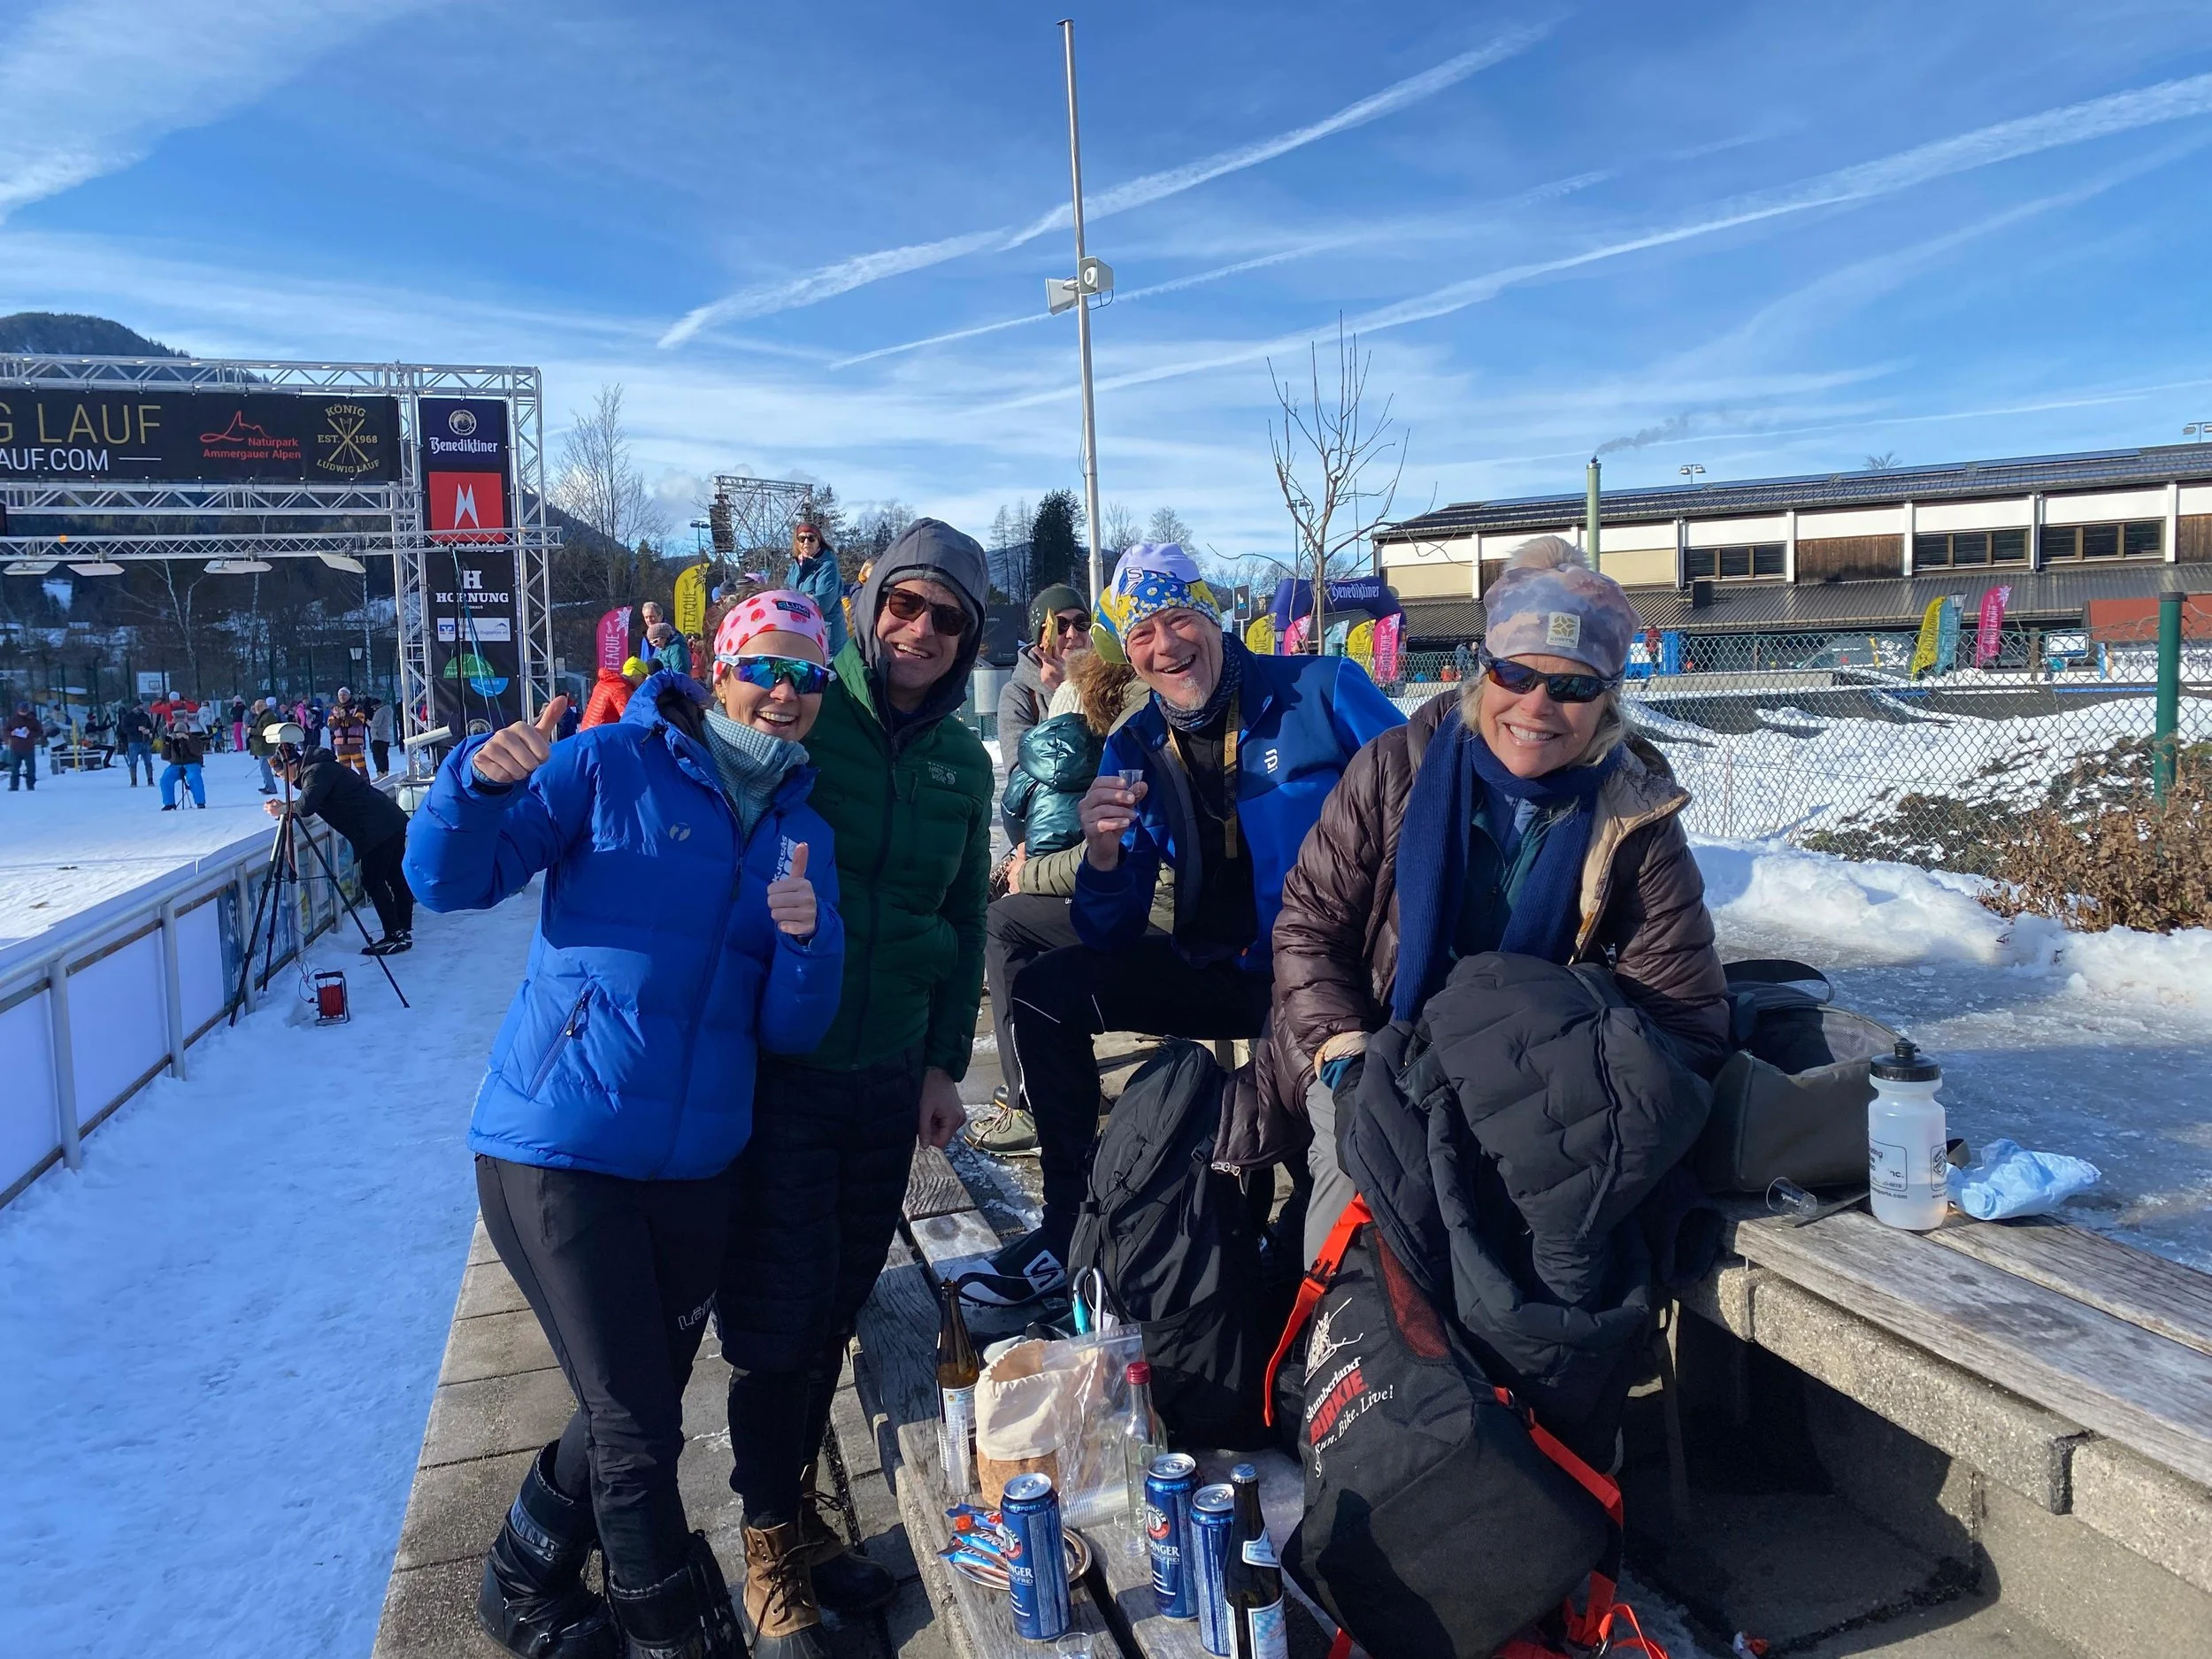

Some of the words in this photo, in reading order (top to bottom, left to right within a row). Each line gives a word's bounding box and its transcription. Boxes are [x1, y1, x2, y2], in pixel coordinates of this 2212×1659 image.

[325, 403, 366, 417] KÖNIG
[37, 403, 161, 444] LAUF
[248, 437, 298, 449] Naturpark
[318, 434, 341, 443] EST.
[355, 434, 378, 443] 1968
[429, 436, 498, 455] Benediktiner
[204, 449, 269, 460] Ammergauer
[272, 449, 301, 460] Alpen
[317, 459, 354, 473] LUDWIG
[357, 459, 380, 472] LAUF
[1332, 584, 1379, 602] Benediktiner
[1310, 1368, 1367, 1446] BIRKIE
[1339, 1409, 1359, 1438] Bike.
[1360, 1384, 1394, 1414] Live!
[1009, 1563, 1033, 1578] NGER
